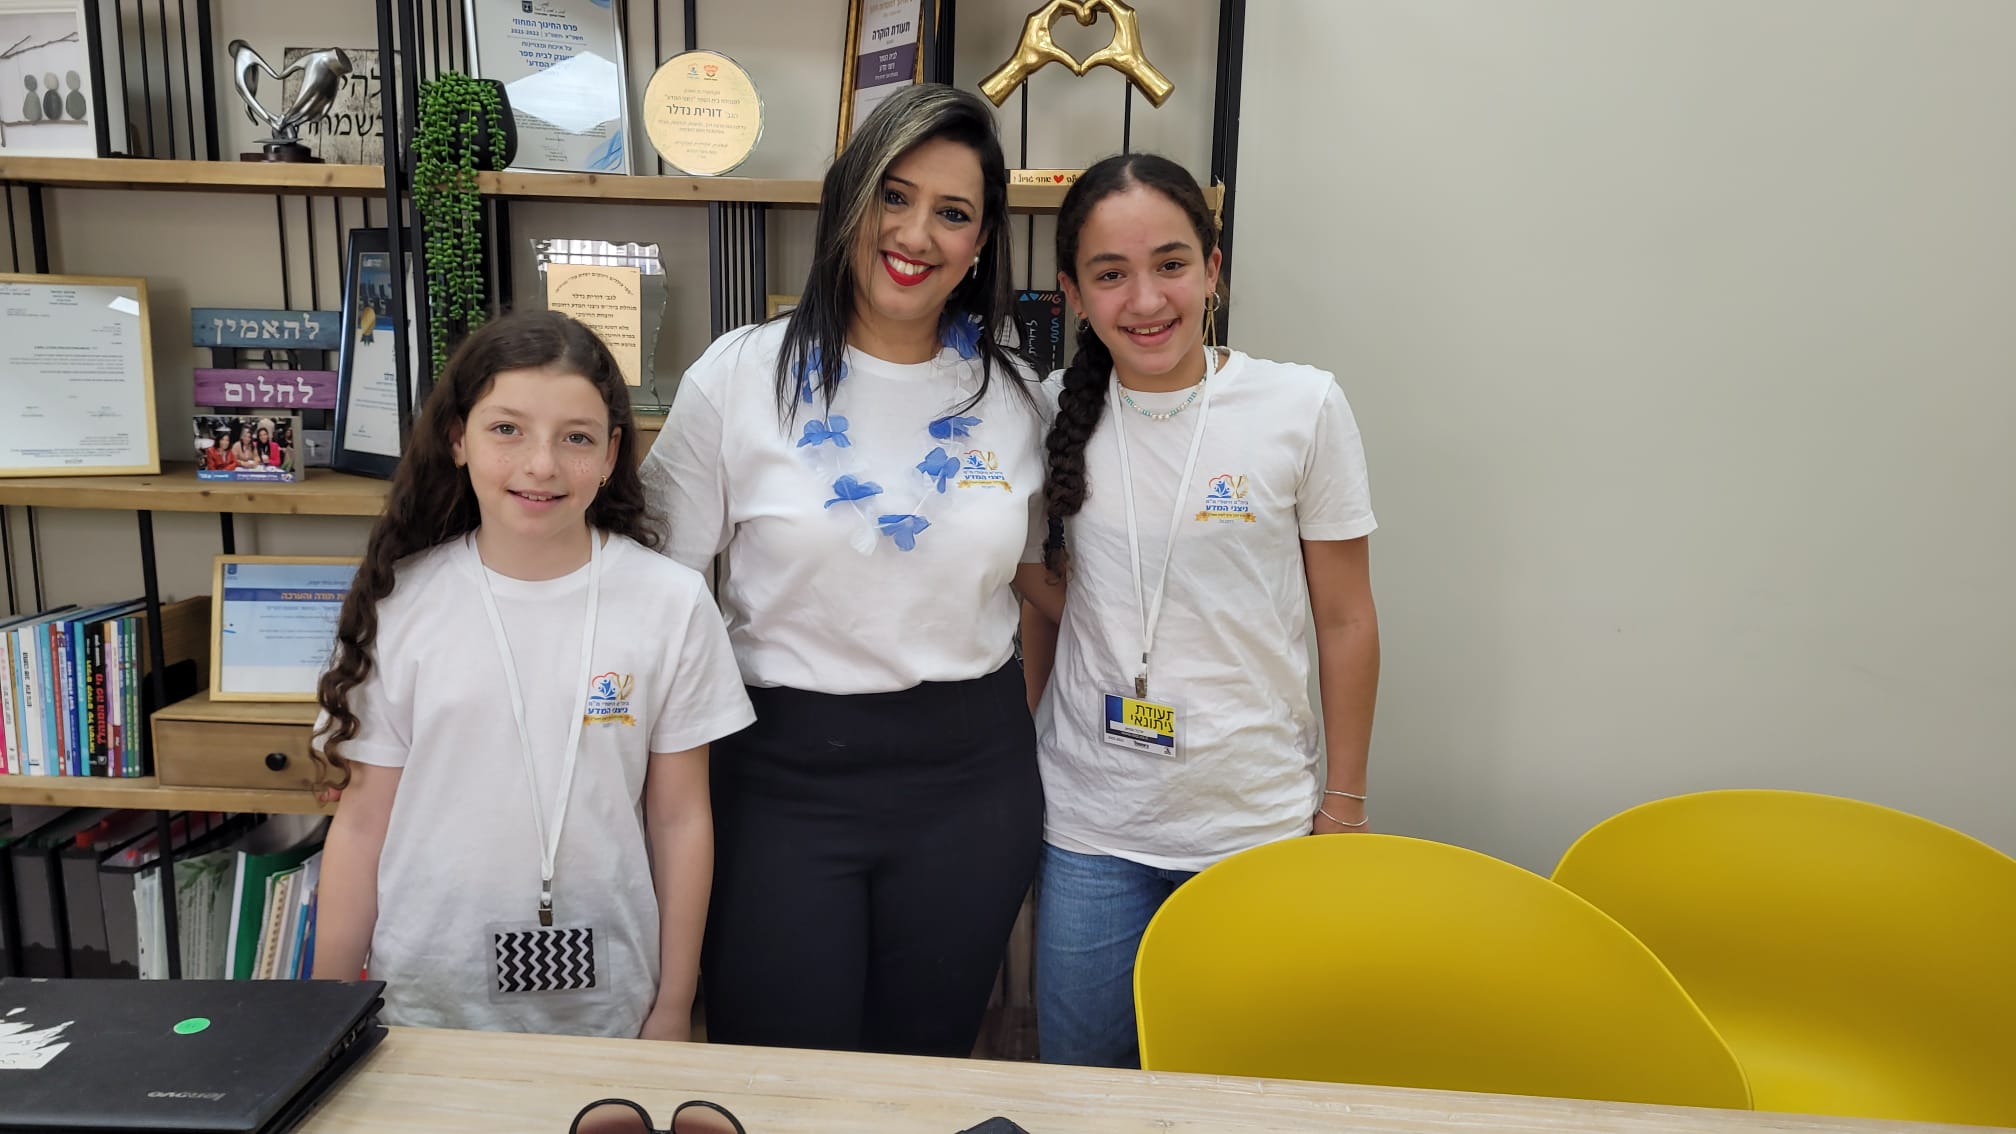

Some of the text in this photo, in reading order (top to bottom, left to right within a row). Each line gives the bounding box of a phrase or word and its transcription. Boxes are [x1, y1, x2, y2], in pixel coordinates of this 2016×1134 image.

[538, 21, 562, 30] החינוך
[562, 24, 578, 32] פרס
[872, 21, 910, 41] תעודת הוקרה
[666, 104, 691, 116] נדלר
[693, 106, 722, 118] דורית
[214, 312, 320, 344] להאמין
[224, 376, 314, 404] לחלום
[1136, 704, 1174, 721] תעודת
[147, 1090, 226, 1102] lenovo
